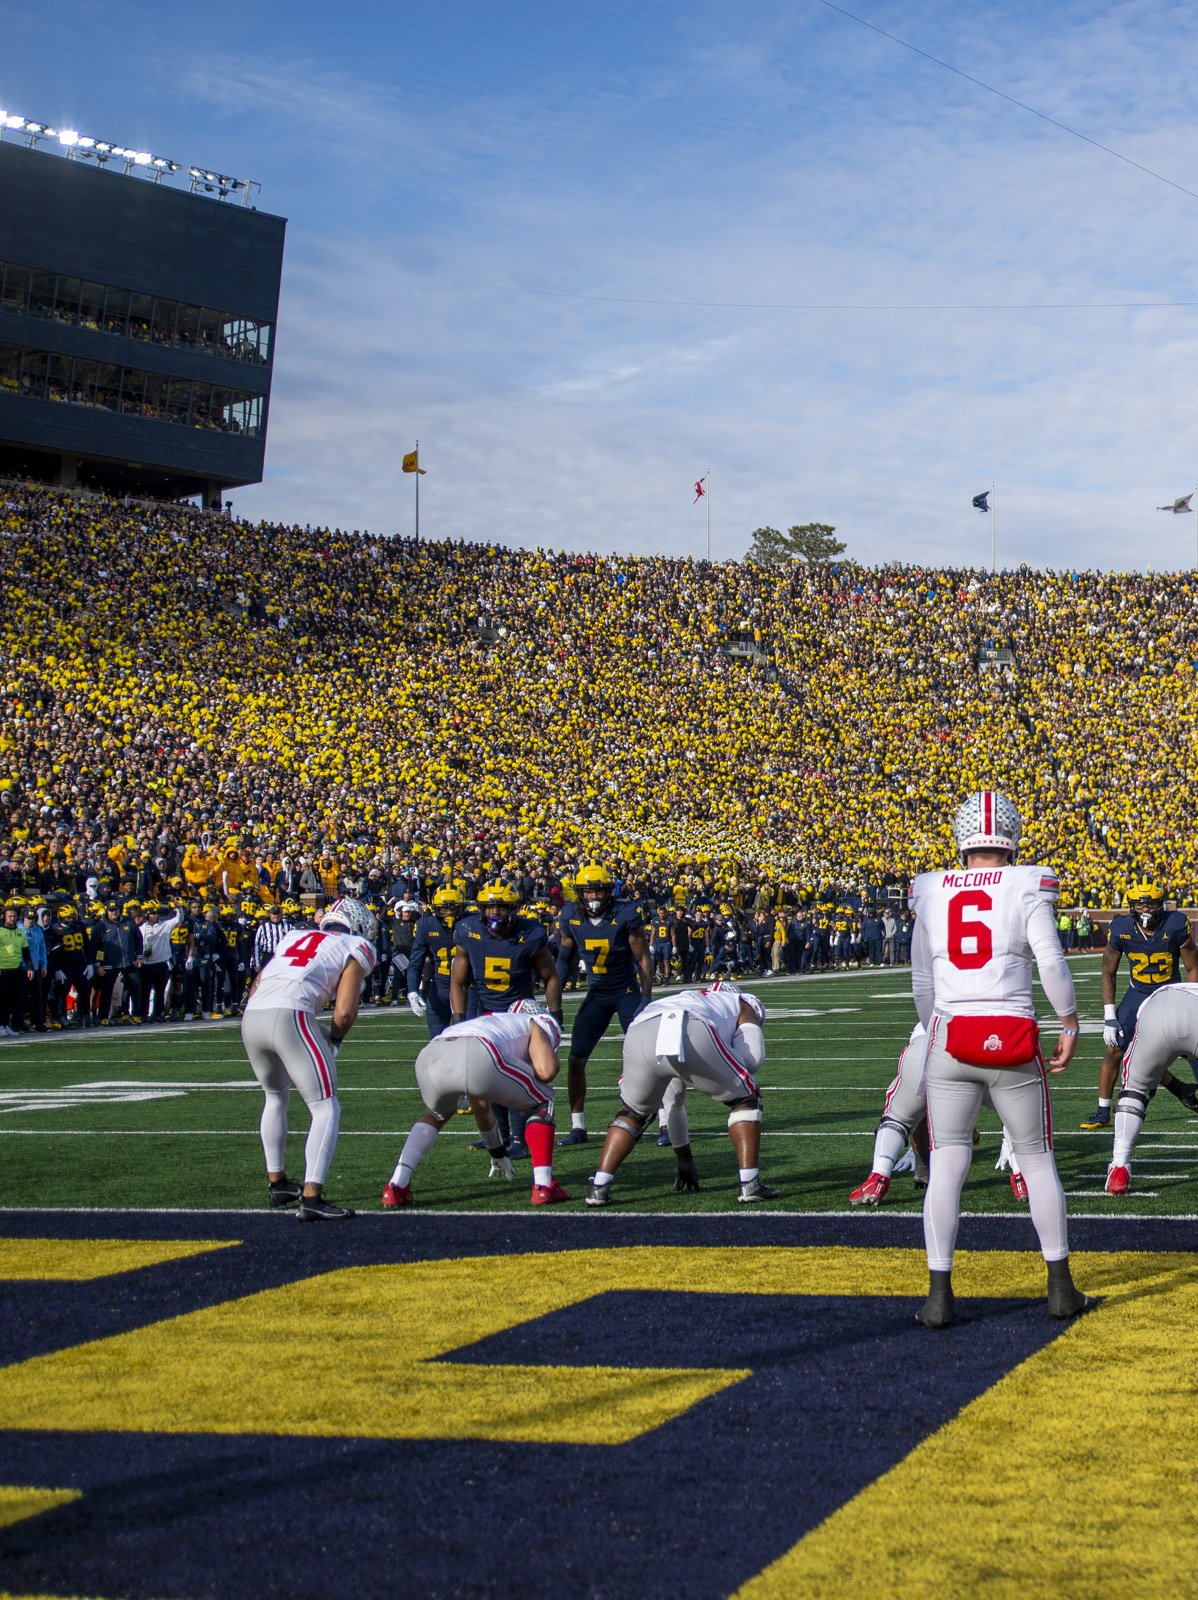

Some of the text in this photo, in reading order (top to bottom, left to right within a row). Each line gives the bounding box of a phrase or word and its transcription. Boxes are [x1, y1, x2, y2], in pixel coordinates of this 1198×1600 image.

[942, 871, 1003, 888] McCORD
[62, 932, 84, 950] 99
[947, 889, 993, 970] 6
[281, 931, 328, 967] 4
[584, 938, 610, 974] 7
[485, 957, 511, 992] 5
[1128, 952, 1173, 983] 23
